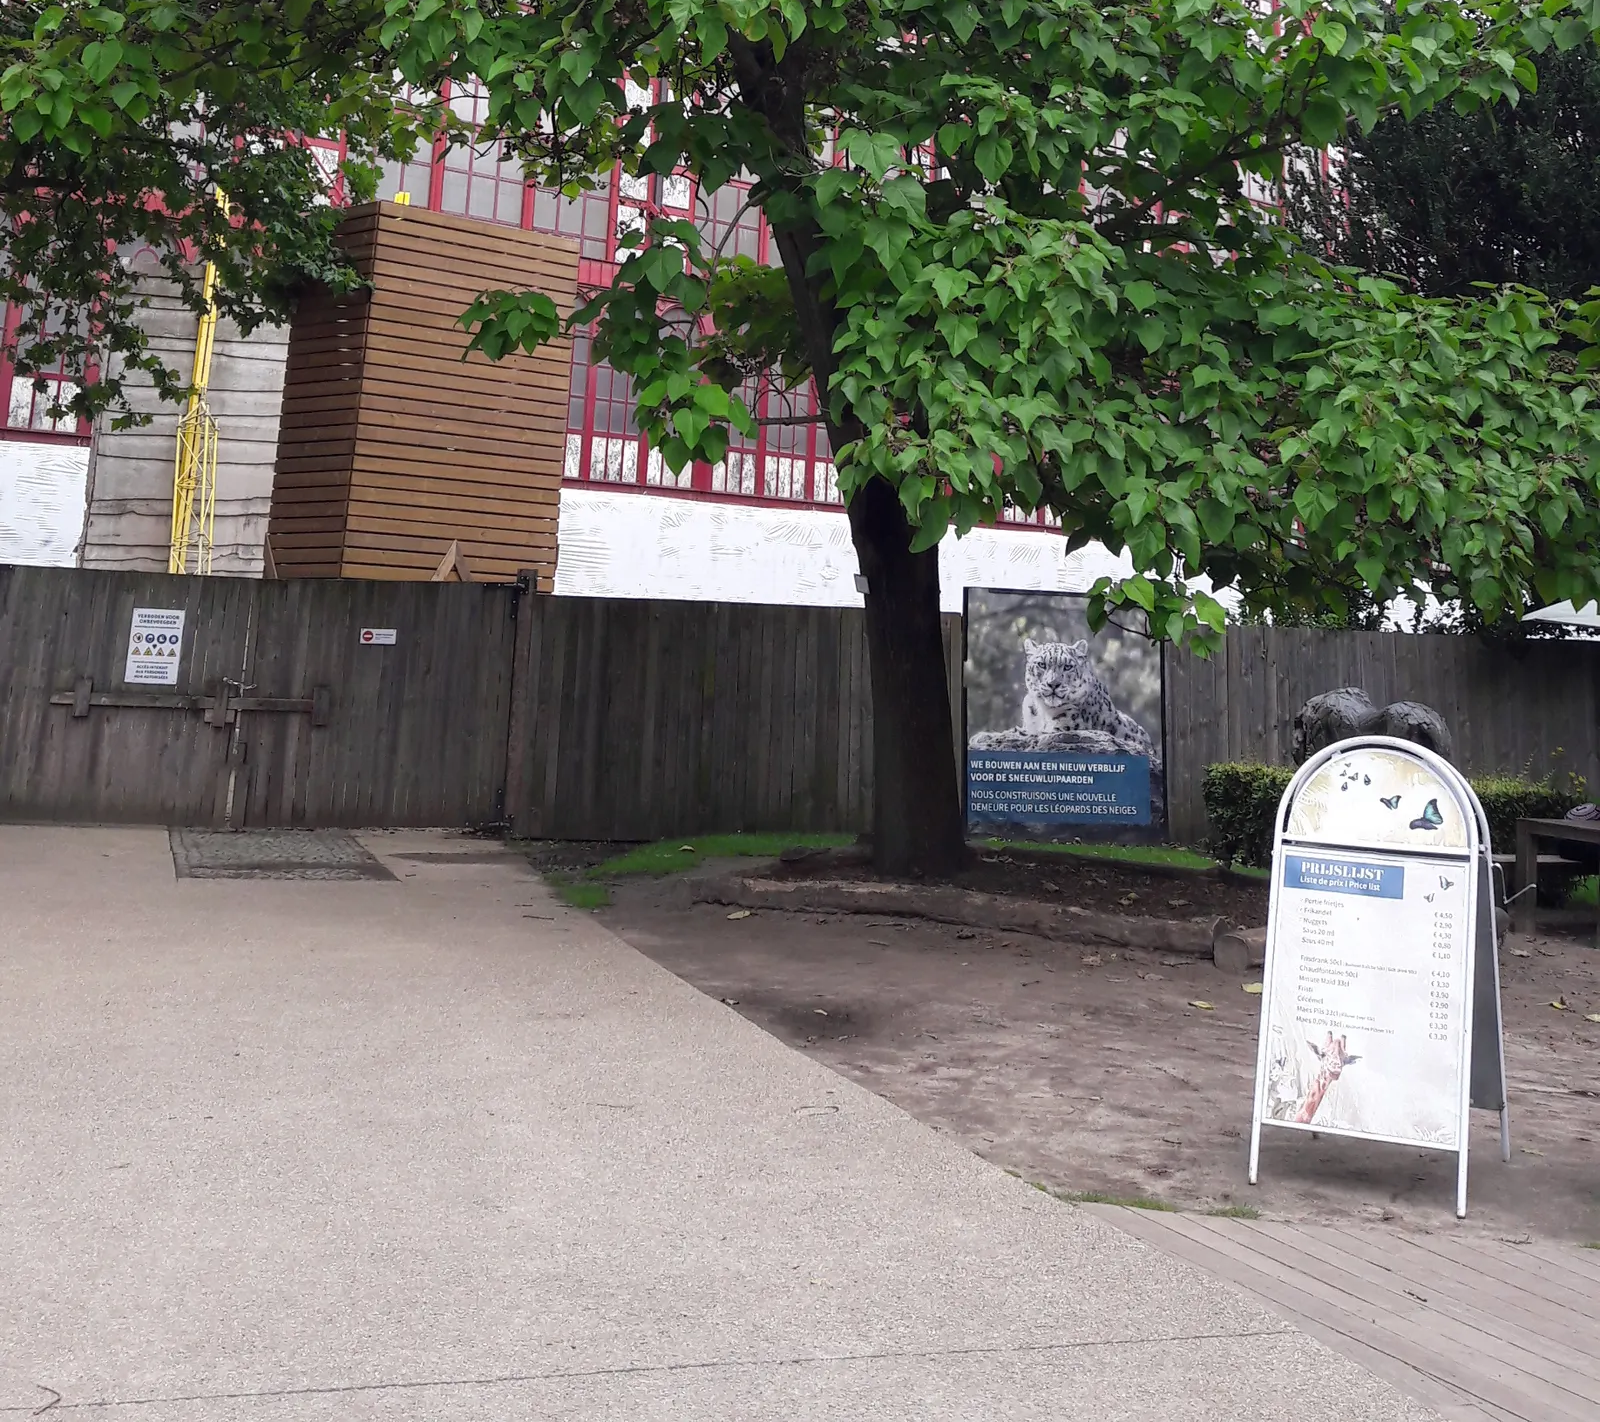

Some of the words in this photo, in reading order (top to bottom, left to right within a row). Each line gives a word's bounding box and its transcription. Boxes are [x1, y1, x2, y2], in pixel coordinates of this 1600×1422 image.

[970, 760, 984, 769] WE
[985, 760, 1022, 770] BOUWEN
[1023, 761, 1040, 771] AAN
[1041, 762, 1058, 771] EEN
[1059, 762, 1087, 772] NIEUW
[1087, 763, 1126, 773] VERBLIJF
[970, 772, 995, 782] VOOR
[996, 773, 1007, 782] DE
[1008, 773, 1094, 784] SNEEUWLUIPAARDEN
[971, 790, 994, 799] NOUS
[995, 790, 1057, 801] CONSTRUISONS
[1058, 792, 1075, 801] UNE
[1076, 793, 1117, 802] NOUVELLE
[971, 802, 1009, 812] DEMEURE
[1010, 803, 1033, 813] POUR
[1034, 804, 1049, 813] LES
[1050, 804, 1091, 814] LÉOPARDS
[1092, 805, 1108, 815] DES
[1109, 806, 1137, 816] NEIGES
[1301, 861, 1385, 881] PRIJSLIJST
[1300, 875, 1318, 885] Liste
[1318, 877, 1328, 886] de
[1329, 878, 1344, 887] prix
[1348, 881, 1368, 890] Price
[1368, 882, 1381, 892] list
